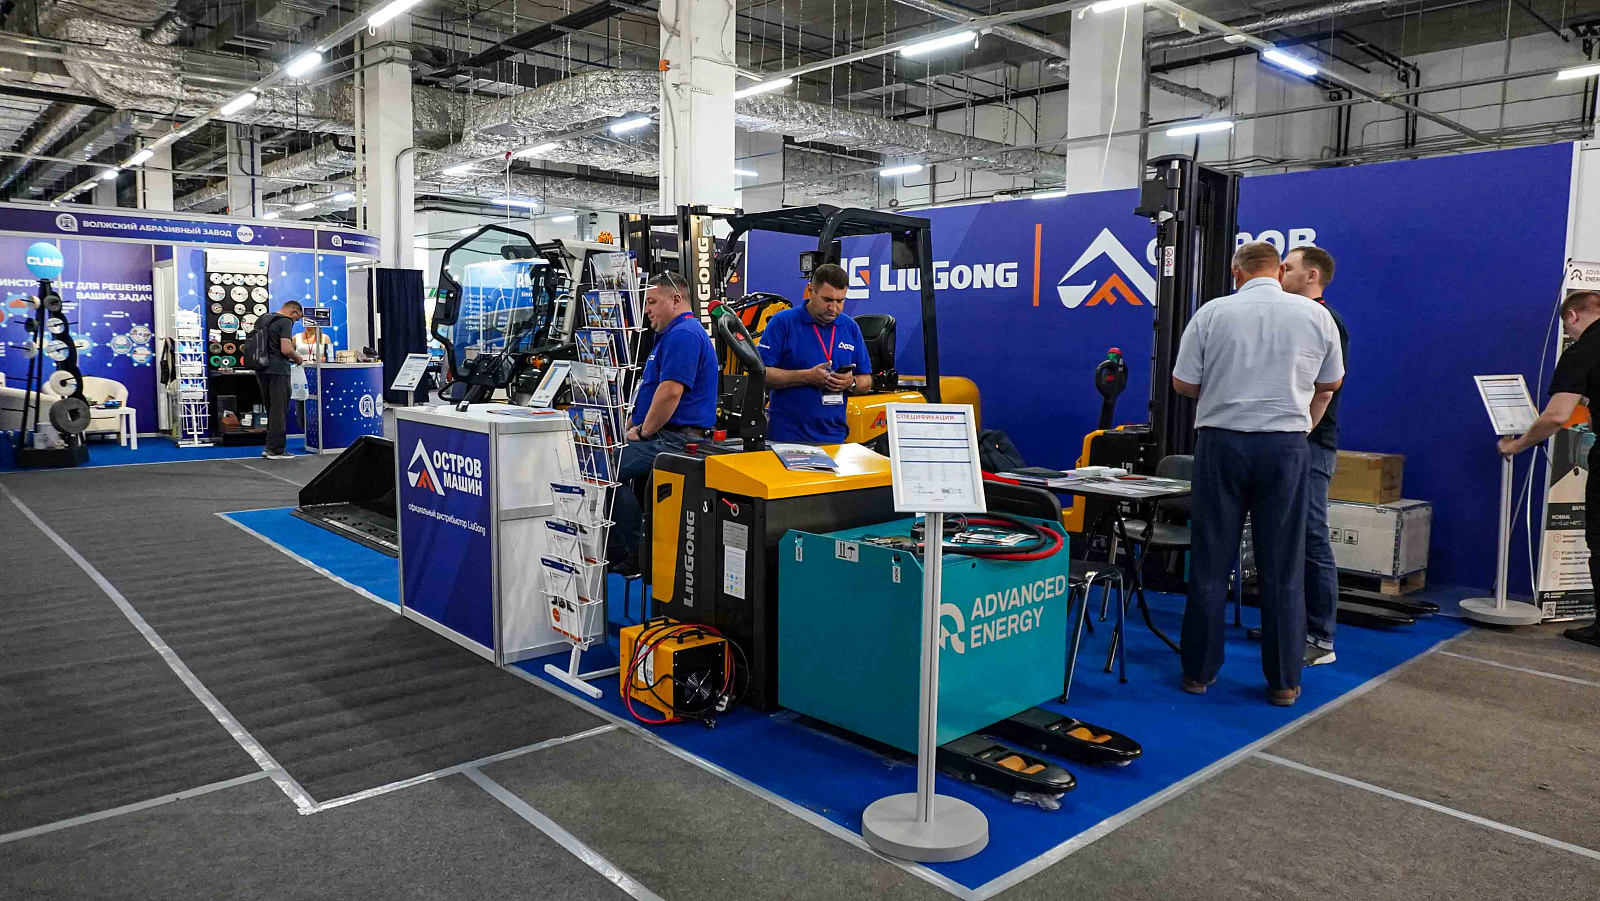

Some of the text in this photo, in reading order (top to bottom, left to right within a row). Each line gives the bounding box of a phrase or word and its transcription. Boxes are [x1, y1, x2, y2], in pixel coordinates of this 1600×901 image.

[83, 220, 232, 238] ВОЛЖСКИЙ АБРАЗИВНЫЙ ЗАВОД
[26, 256, 63, 268] CUMI
[0, 278, 153, 292] ИНСТРЕНТ ДЛЯ РЕШЕНИЯ
[76, 291, 153, 303] ВАШИХ ЗАДАЧ
[896, 413, 955, 421] СПЕЦИФИКАЦИЯ
[433, 450, 482, 478] ОСТРОВ
[443, 471, 483, 497] МАШИН
[408, 502, 486, 537] официальный дистрибьютор LiuGong
[970, 574, 1067, 622] ADVANCED
[970, 605, 1045, 649] ENERGY
